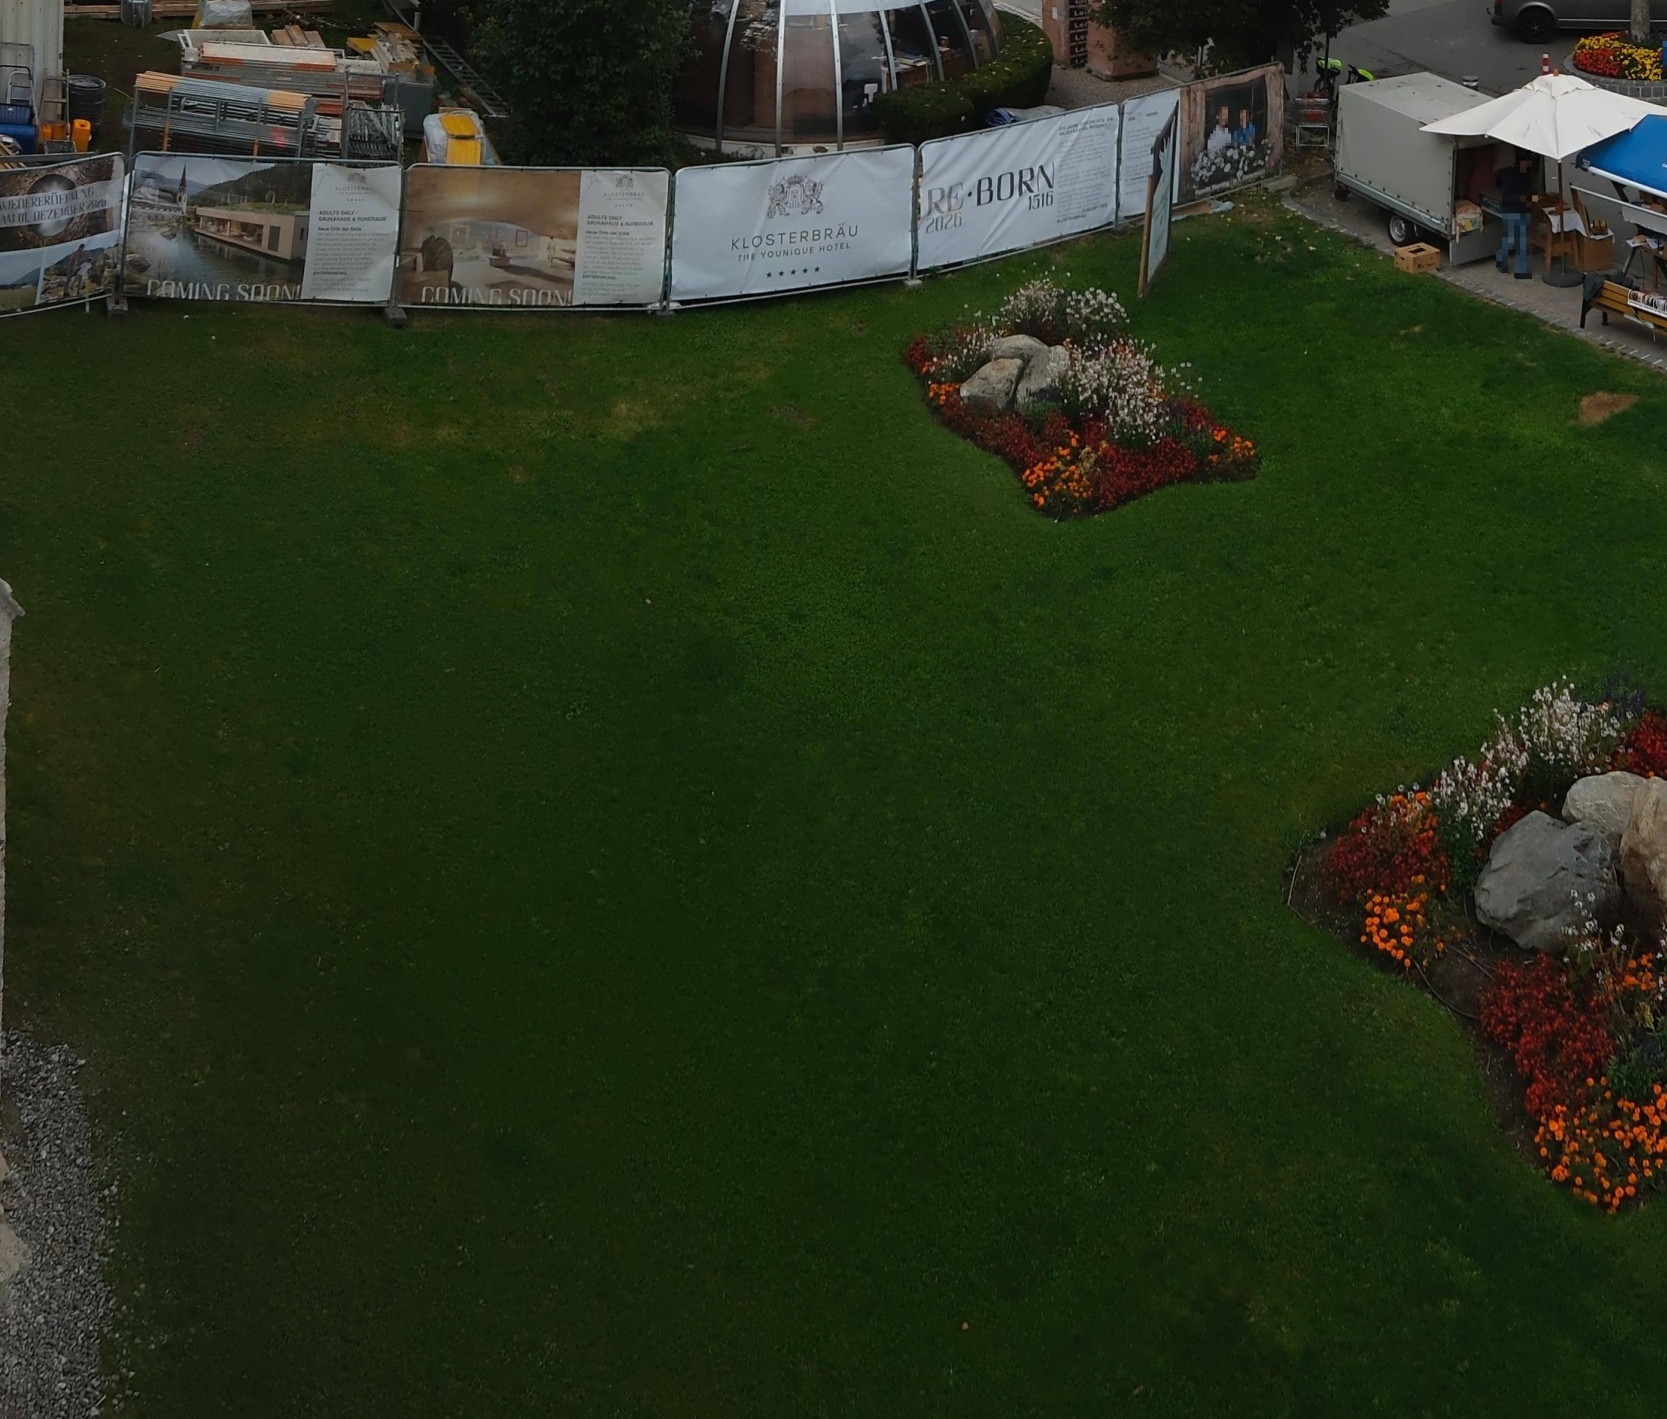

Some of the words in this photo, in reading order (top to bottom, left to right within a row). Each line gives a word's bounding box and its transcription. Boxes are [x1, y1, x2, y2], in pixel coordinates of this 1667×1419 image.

[1028, 191, 1054, 210] 1516
[925, 212, 962, 234] 2026
[731, 223, 859, 251] KLOSTERBRÄU
[738, 253, 756, 261] THE
[761, 246, 815, 259] YOUNIQUE
[818, 242, 851, 253] HOTEL
